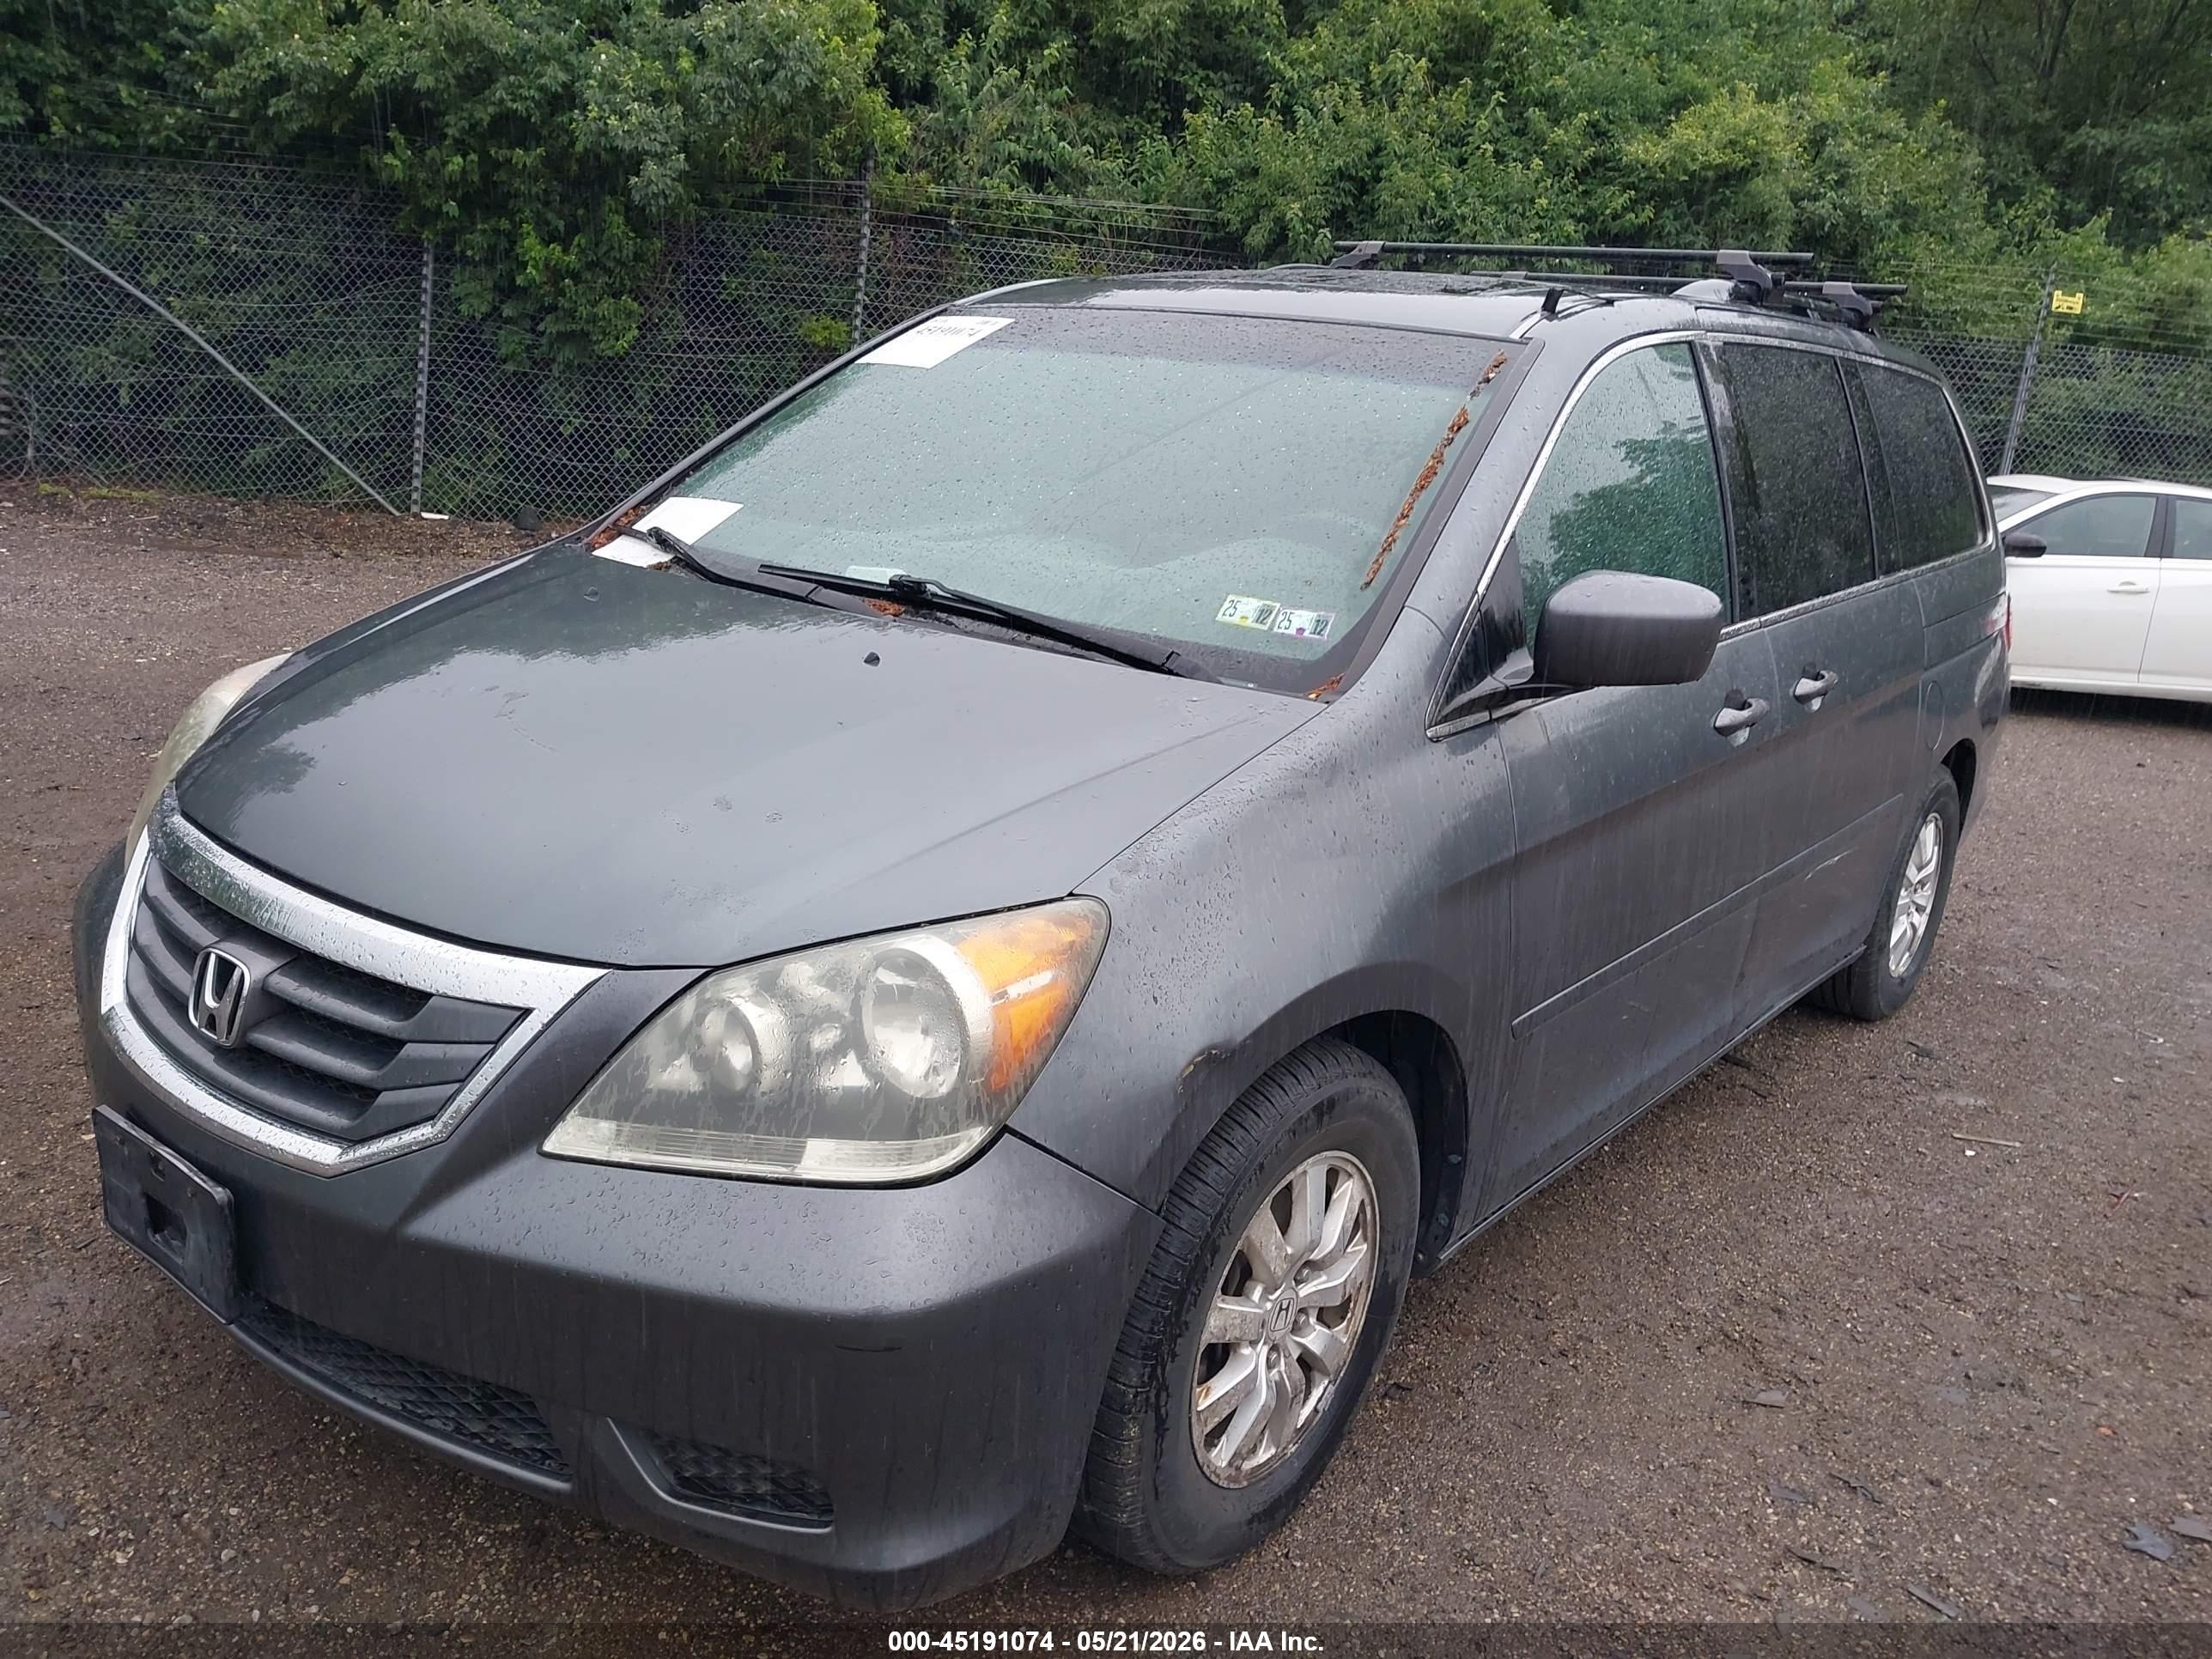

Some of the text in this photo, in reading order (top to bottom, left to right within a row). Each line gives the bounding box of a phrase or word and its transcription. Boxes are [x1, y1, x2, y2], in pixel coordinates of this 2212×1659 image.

[1222, 599, 1274, 625] 25 12
[1277, 611, 1328, 635] 25 12
